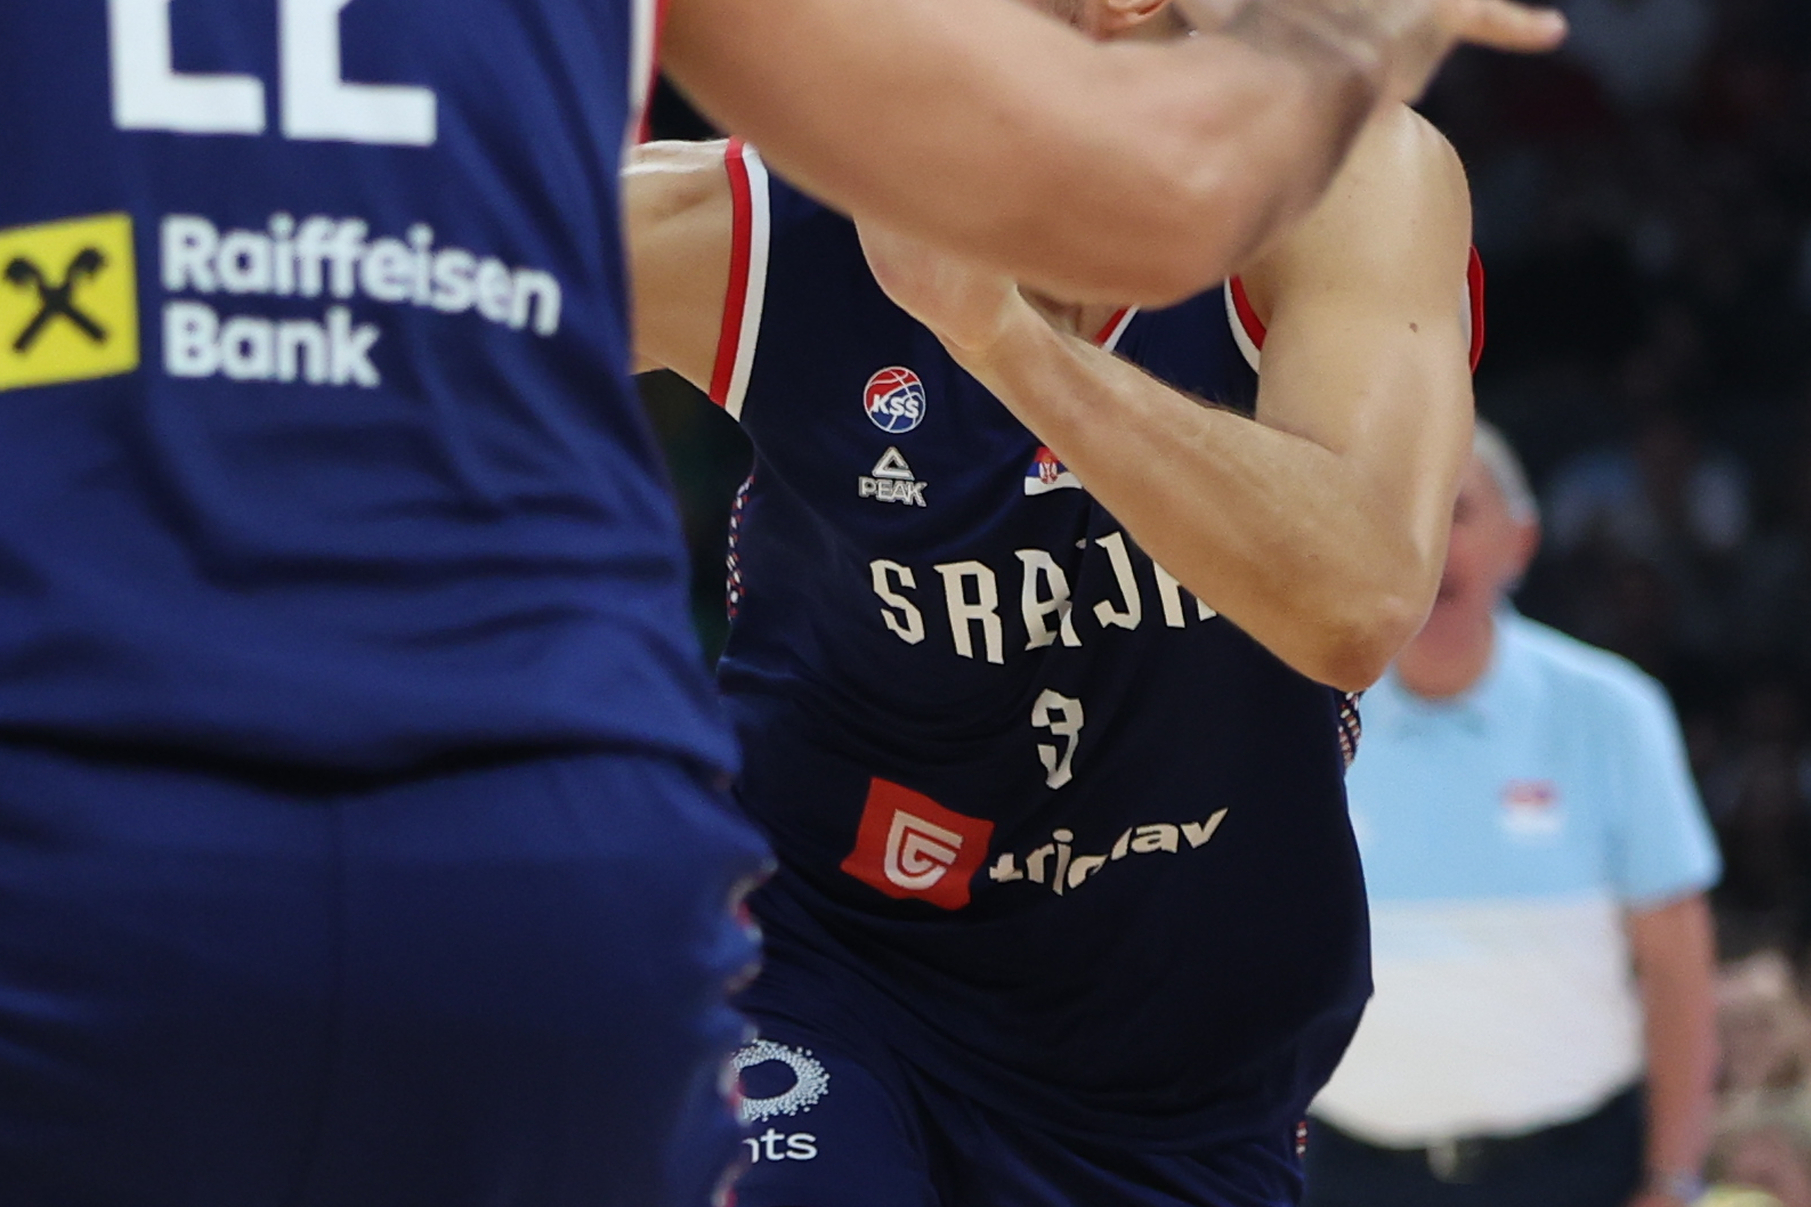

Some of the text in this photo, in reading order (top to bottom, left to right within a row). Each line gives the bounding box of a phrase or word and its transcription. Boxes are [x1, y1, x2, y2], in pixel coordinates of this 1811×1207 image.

[159, 214, 562, 338] Raiffeisen
[160, 301, 381, 389] Bank
[871, 393, 920, 419] KSS
[857, 475, 929, 509] PEAK
